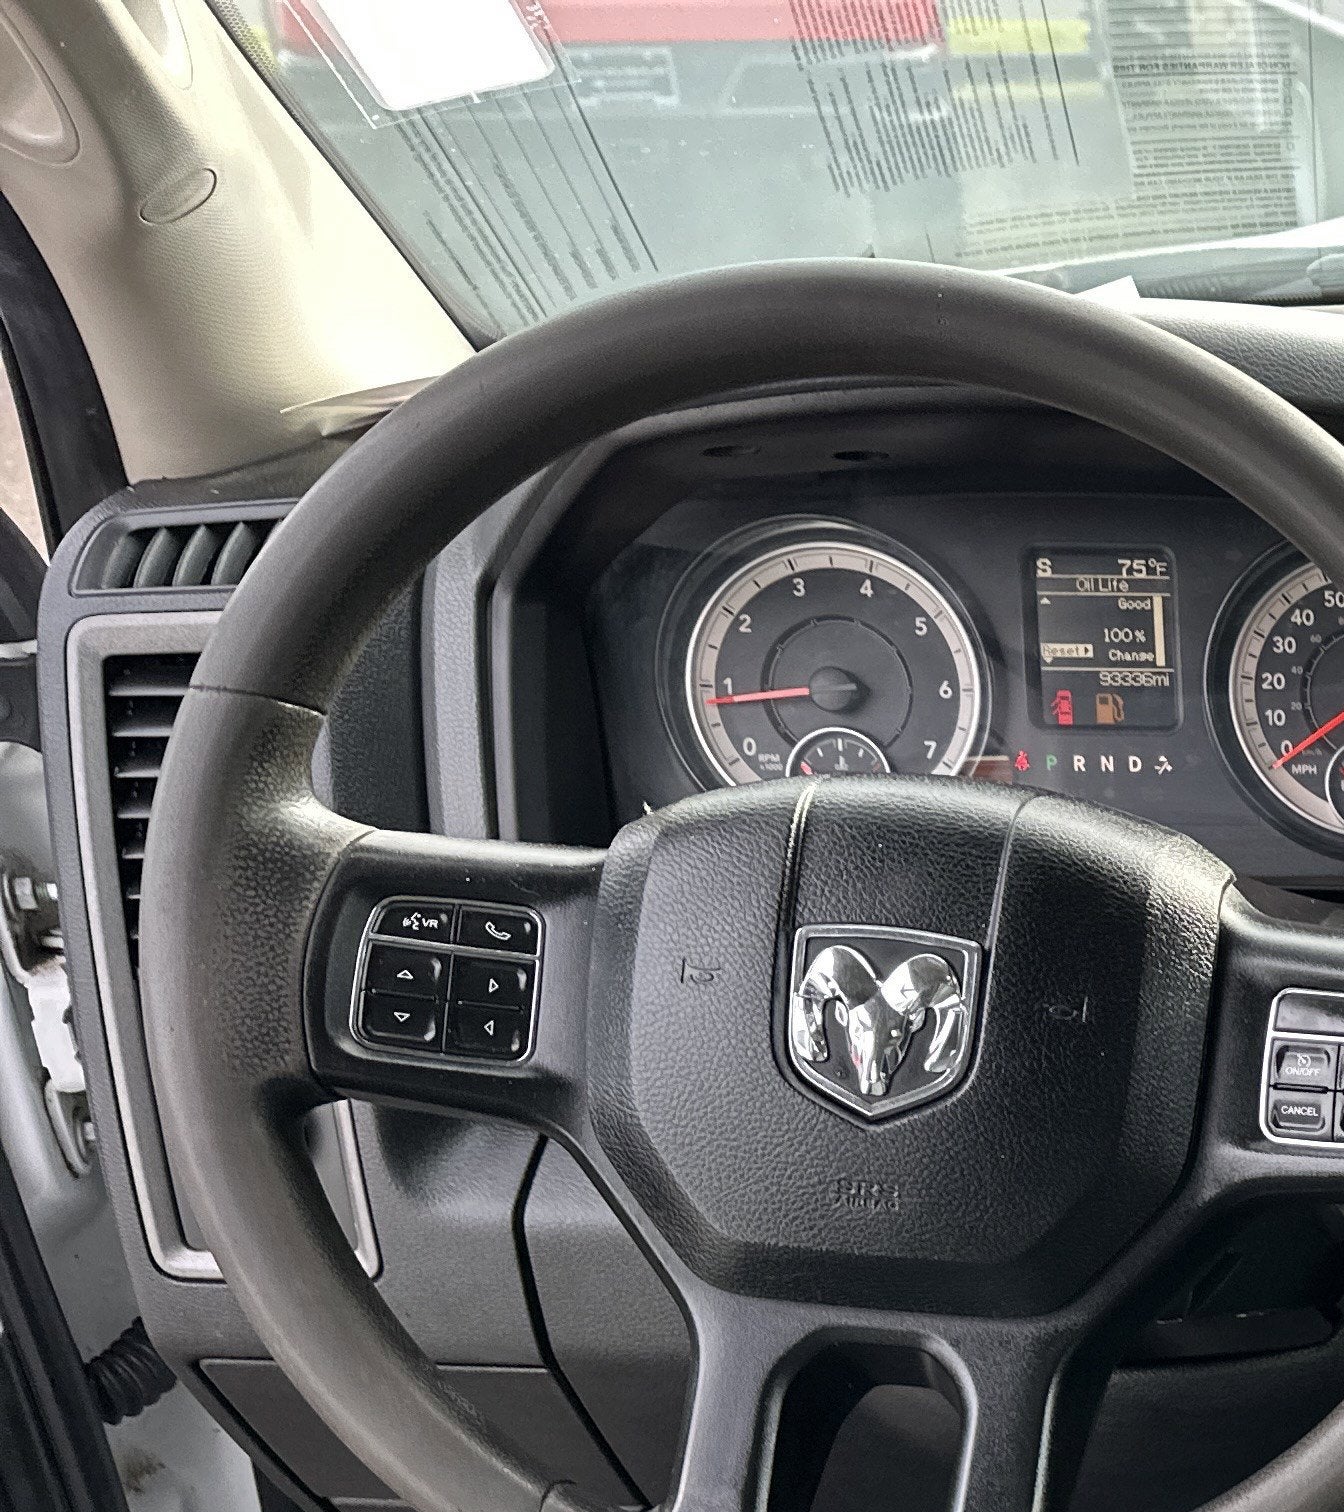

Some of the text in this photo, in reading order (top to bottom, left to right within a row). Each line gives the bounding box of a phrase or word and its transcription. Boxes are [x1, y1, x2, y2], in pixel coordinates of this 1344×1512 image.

[1118, 558, 1167, 577] 75°F
[792, 579, 806, 596] 3
[860, 579, 874, 597] 4
[1118, 598, 1151, 610] Good
[738, 614, 752, 633] 2
[1290, 609, 1314, 626] 40
[915, 618, 927, 636] 5
[1272, 636, 1296, 654] 30
[723, 678, 734, 694] 1
[939, 680, 952, 699] 6
[1261, 672, 1286, 690] 20
[1266, 709, 1286, 726] 10
[742, 737, 756, 756] 0
[924, 740, 936, 759] 7
[1074, 755, 1085, 771] R
[1101, 756, 1113, 772] N
[1129, 757, 1142, 772] D
[1292, 764, 1317, 775] MPH
[421, 917, 438, 929] VR
[1281, 1106, 1318, 1117] CANCEL
